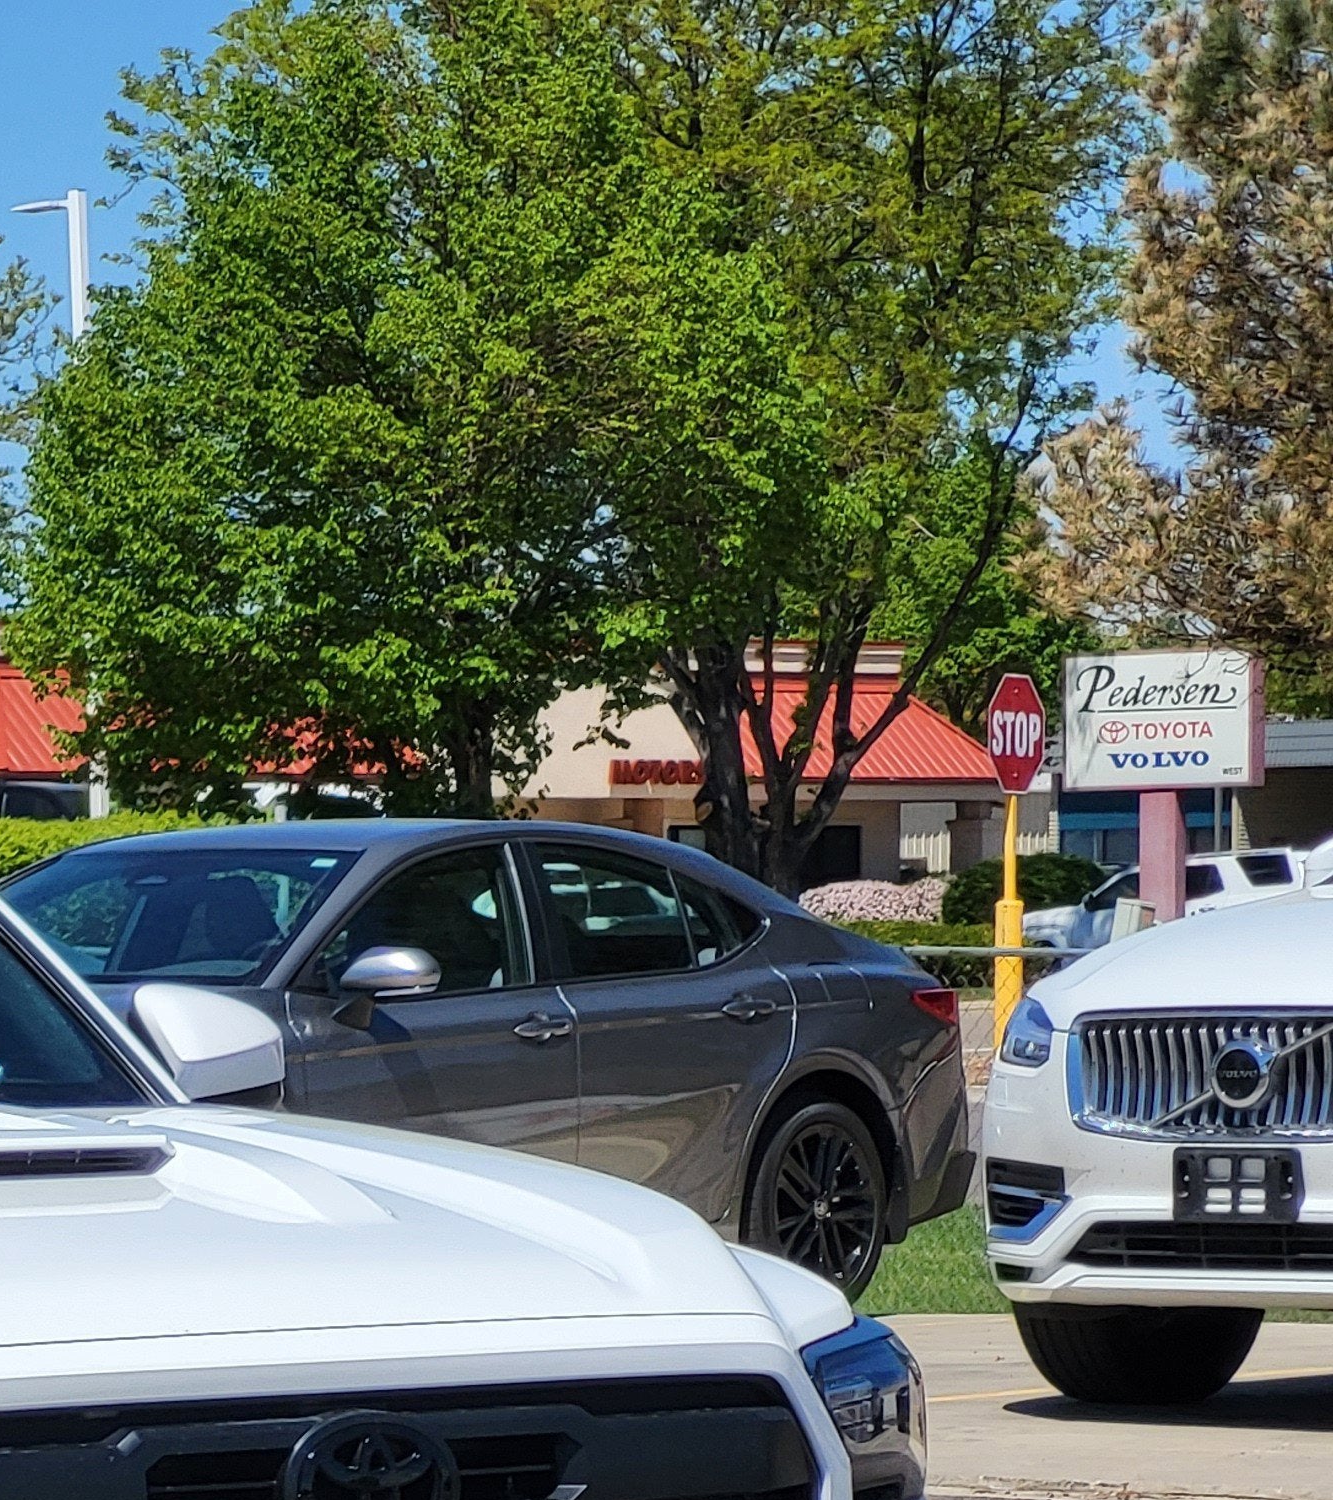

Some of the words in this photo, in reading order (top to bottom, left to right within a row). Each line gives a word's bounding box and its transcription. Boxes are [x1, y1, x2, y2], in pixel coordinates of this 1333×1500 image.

[1076, 665, 1237, 713] Pedersen
[992, 710, 1041, 758] STOP
[1132, 721, 1214, 740] TOYOTA
[1107, 750, 1209, 769] VOLVO
[1222, 767, 1244, 776] WEST
